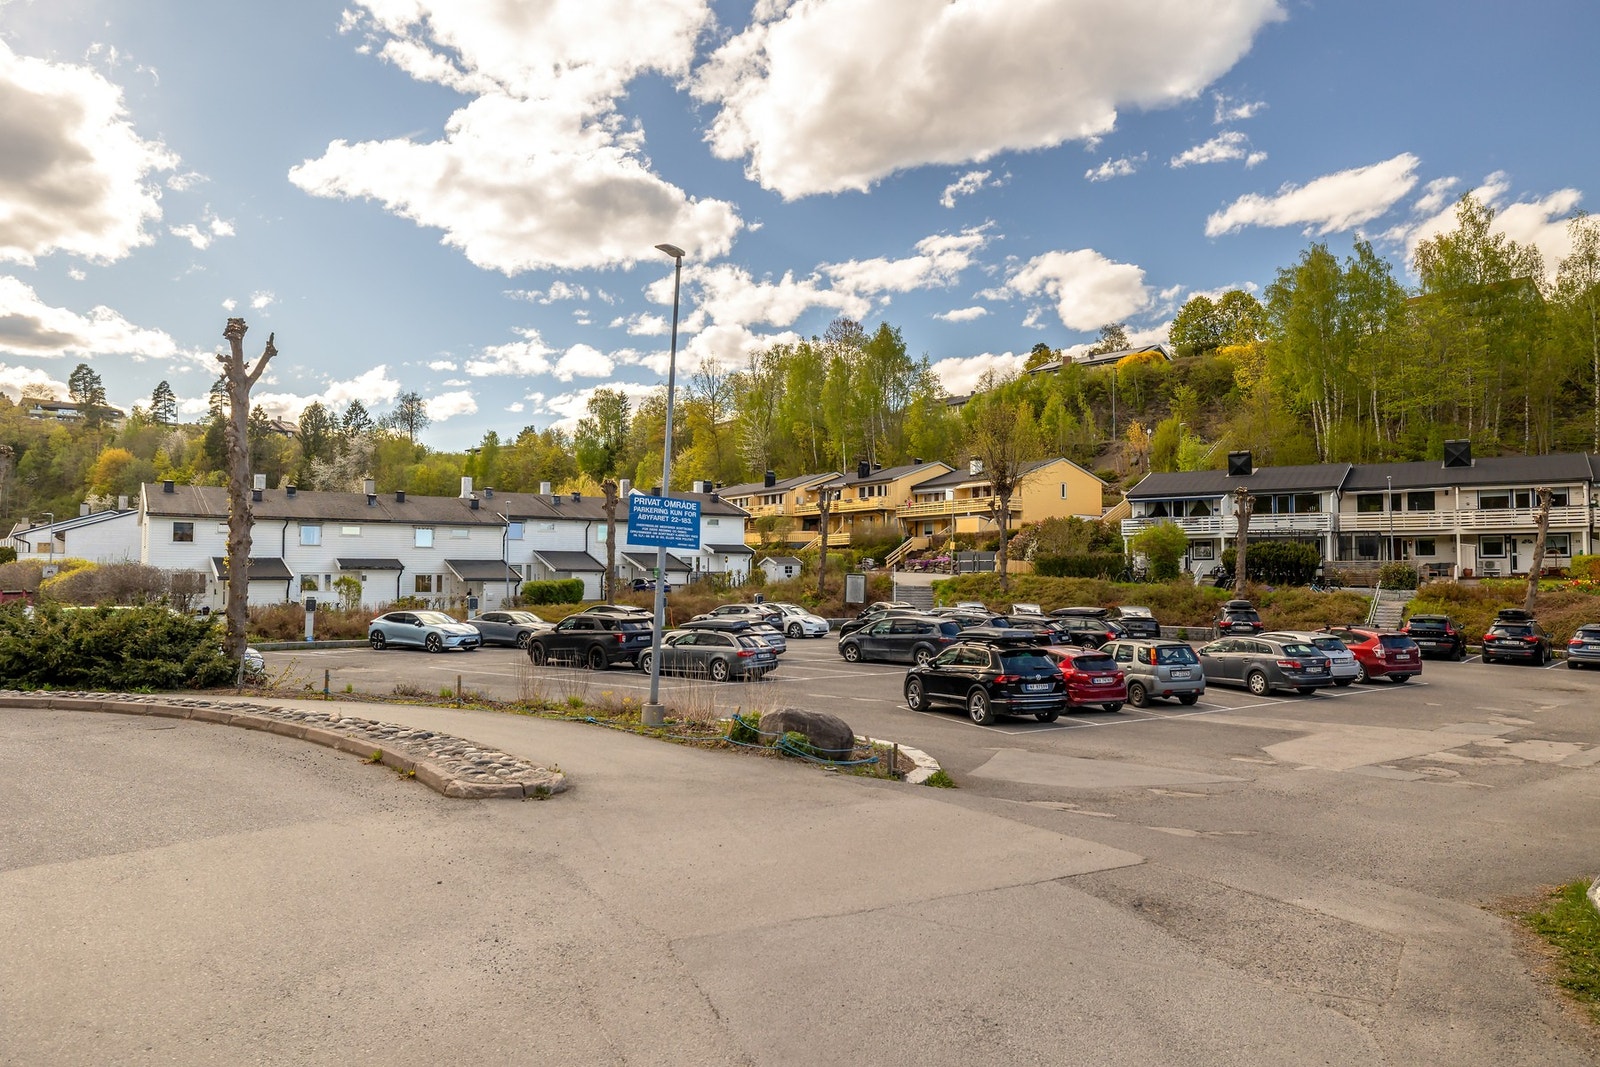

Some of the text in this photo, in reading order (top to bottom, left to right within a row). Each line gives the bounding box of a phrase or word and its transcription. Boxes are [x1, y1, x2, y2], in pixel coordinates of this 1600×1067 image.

[634, 497, 696, 510] PRIVAT OMRÅDE
[633, 506, 668, 514] PARKERING
